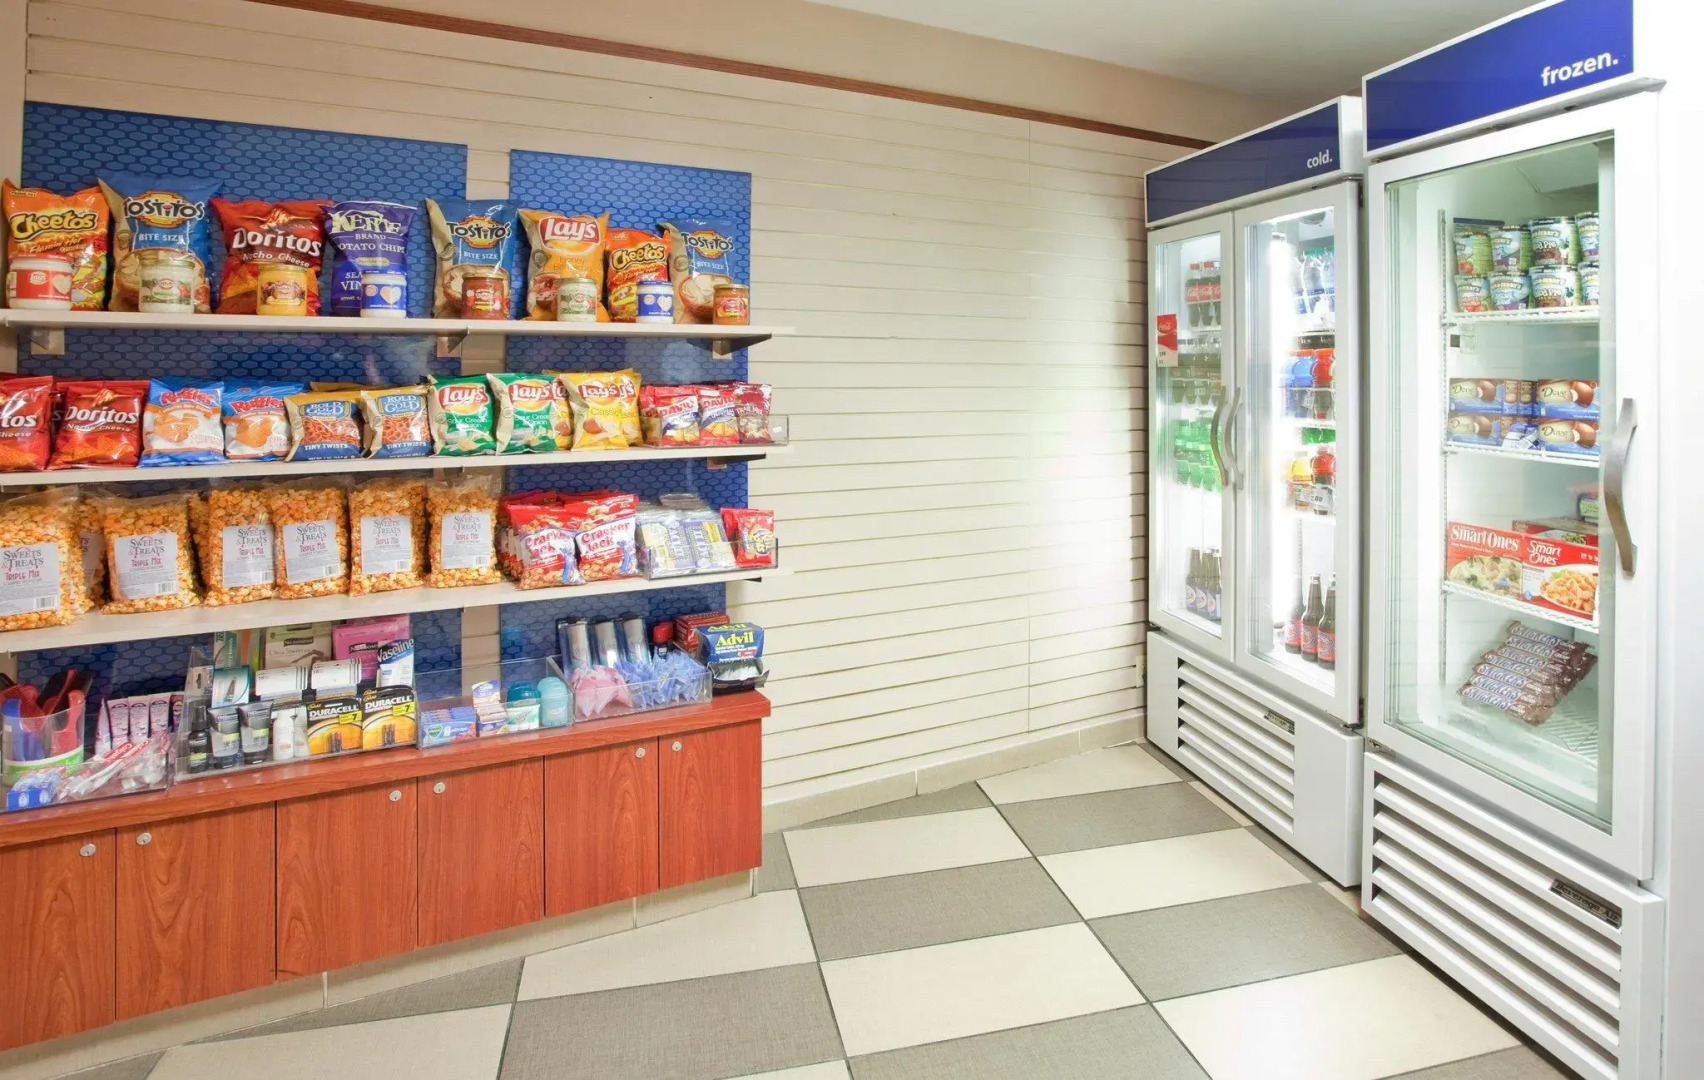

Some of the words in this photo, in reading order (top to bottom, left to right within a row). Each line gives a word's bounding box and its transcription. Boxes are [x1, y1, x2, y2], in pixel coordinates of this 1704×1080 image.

[1541, 52, 1618, 87] frozen.
[1306, 150, 1332, 168] cold.
[10, 210, 97, 240] Cheetos
[139, 233, 159, 241] BITE
[232, 227, 322, 257] Doritos
[278, 252, 310, 268] Cheese
[611, 243, 665, 271] Cheetos
[386, 394, 417, 402] ROLD
[384, 400, 420, 412] GOLD
[66, 406, 139, 424] Doritos
[304, 443, 321, 451] TINY
[386, 442, 402, 450] TINY
[581, 521, 630, 544] Cracker
[130, 538, 163, 548] SWEETS
[1527, 540, 1562, 557] Smart
[3, 549, 42, 559] SWEETS
[134, 545, 165, 560] TREATS
[1529, 552, 1558, 566] Ones
[7, 557, 44, 572] TREATS
[716, 632, 754, 647] Advil
[377, 638, 414, 662] Vaseline
[365, 695, 412, 710] DURACELL
[404, 704, 410, 712] 7
[310, 704, 359, 717] DURACELL
